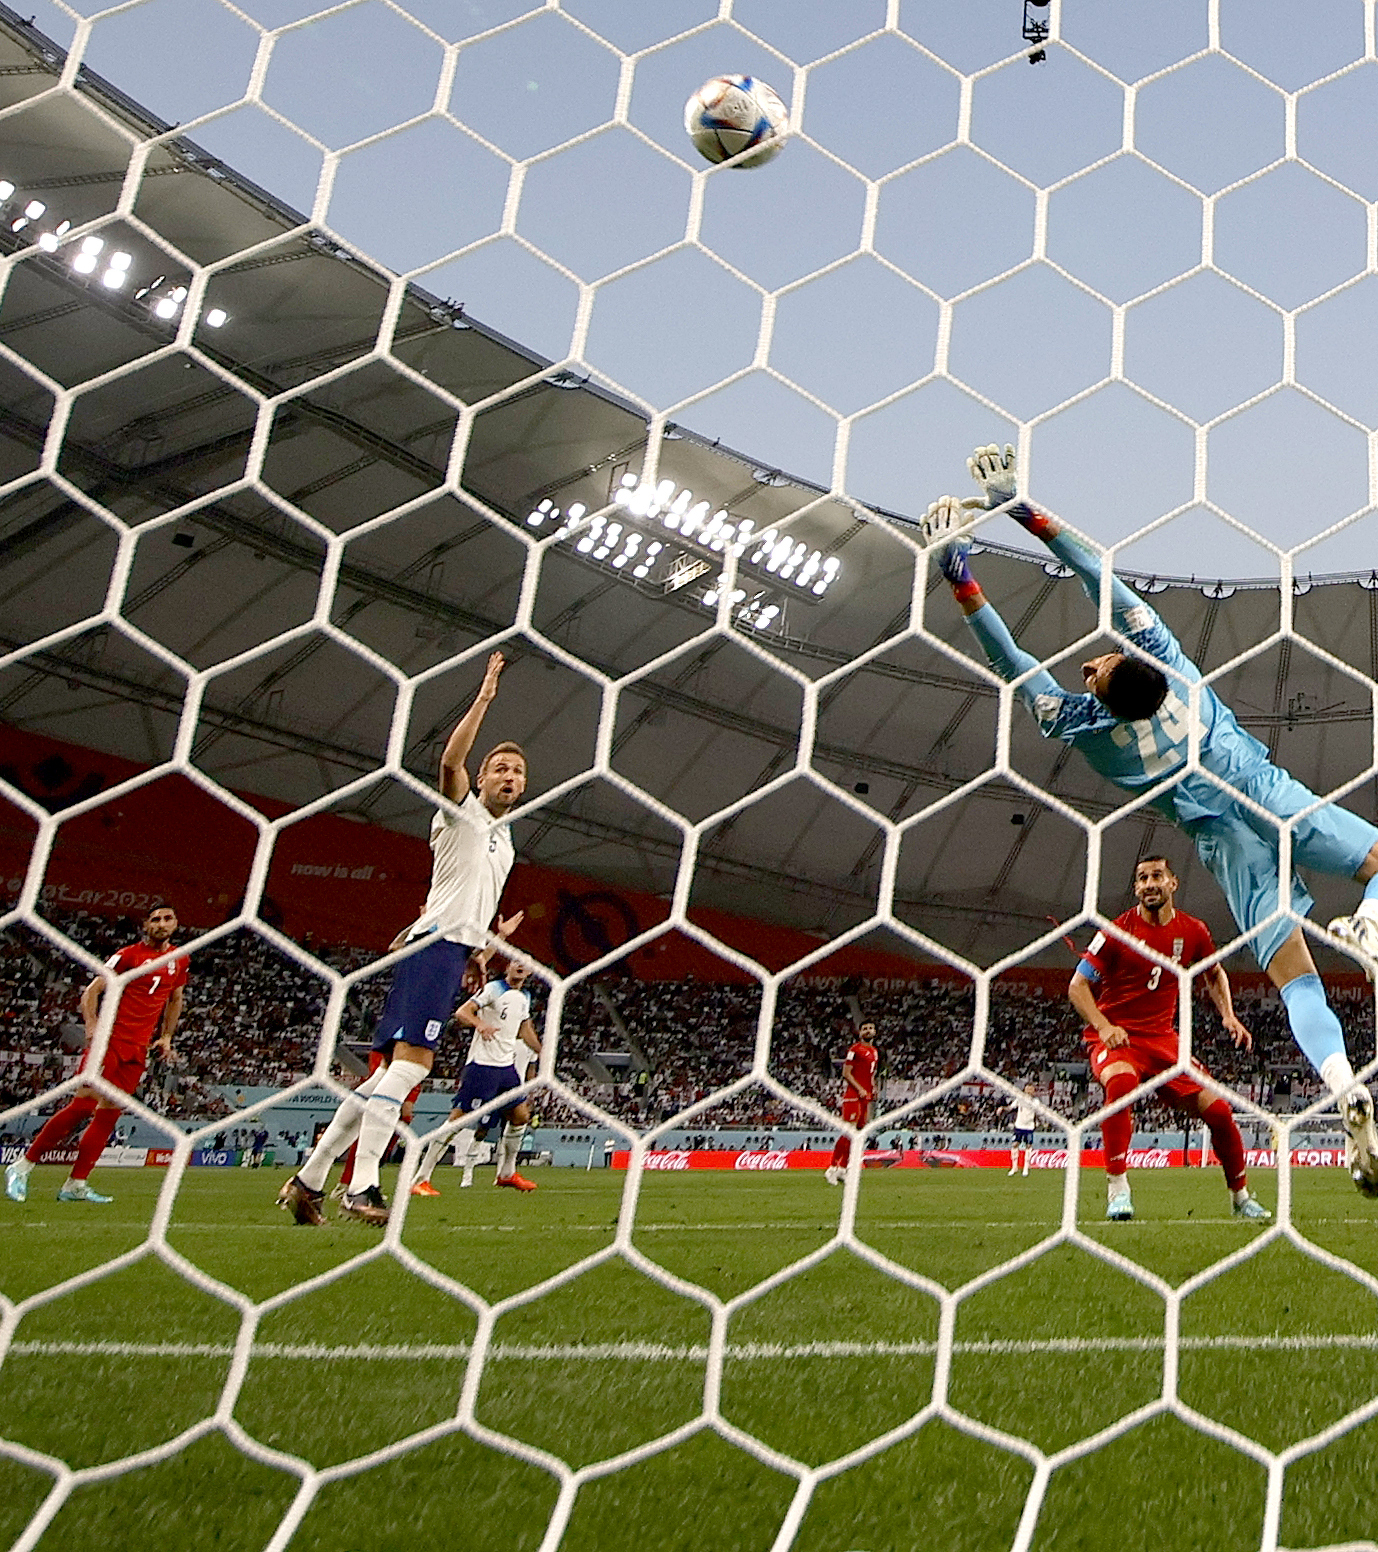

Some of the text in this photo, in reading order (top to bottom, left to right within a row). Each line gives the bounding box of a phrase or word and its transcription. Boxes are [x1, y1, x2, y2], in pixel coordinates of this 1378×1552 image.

[148, 975, 162, 995] 7
[1147, 965, 1162, 991] 3
[500, 1006, 508, 1021] 6
[1, 1147, 26, 1164] VISA
[735, 1150, 790, 1170] Coca-Cola
[1297, 1150, 1333, 1167] FOR
